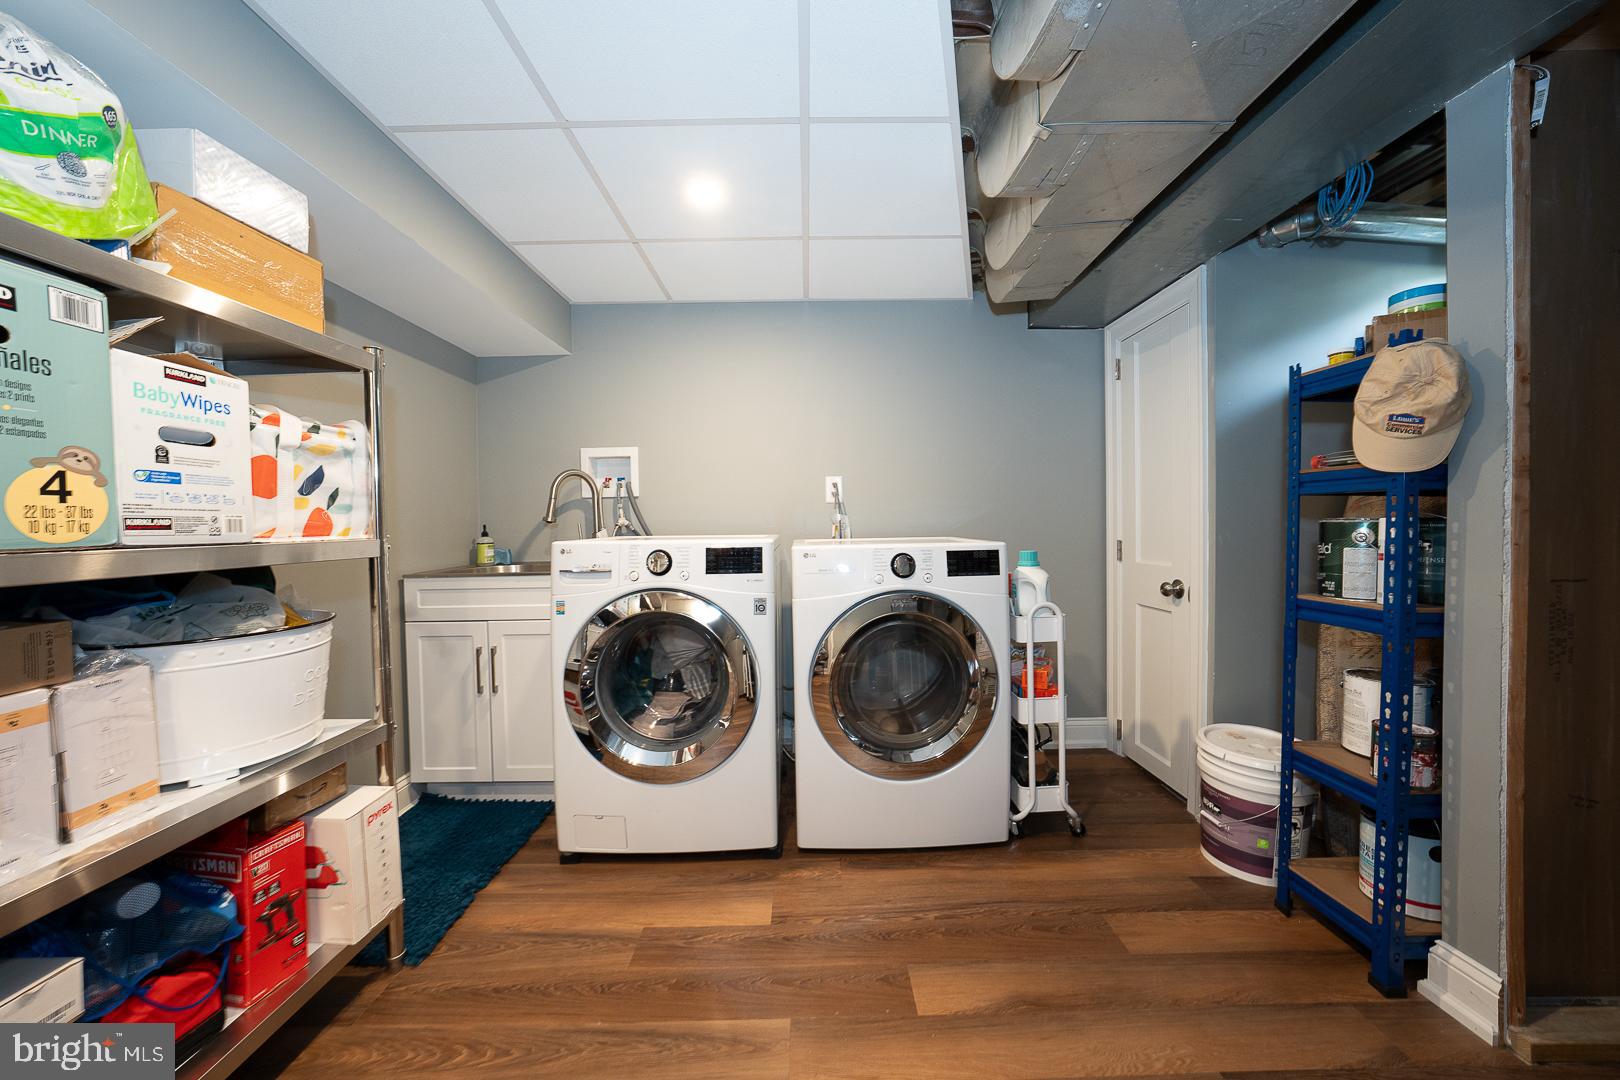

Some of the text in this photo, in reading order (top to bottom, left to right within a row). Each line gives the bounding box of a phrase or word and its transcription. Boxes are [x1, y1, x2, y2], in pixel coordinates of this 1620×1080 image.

[103, 110, 117, 123] 165
[20, 118, 98, 149] DINNER
[140, 406, 226, 428] FRAGRANCE FREE
[1385, 427, 1423, 435] SERVICES
[39, 470, 73, 504] 4
[23, 504, 38, 519] 22
[41, 505, 57, 519] lbs
[65, 505, 78, 519] 37
[79, 505, 95, 519] lbs
[28, 520, 40, 534] 10
[44, 520, 57, 536] kg
[65, 520, 76, 533] 17
[79, 520, 91, 535] kg
[124, 518, 172, 527] KIRKLAND
[367, 801, 394, 827] pyrex
[252, 831, 302, 862] CRAFTSMAN
